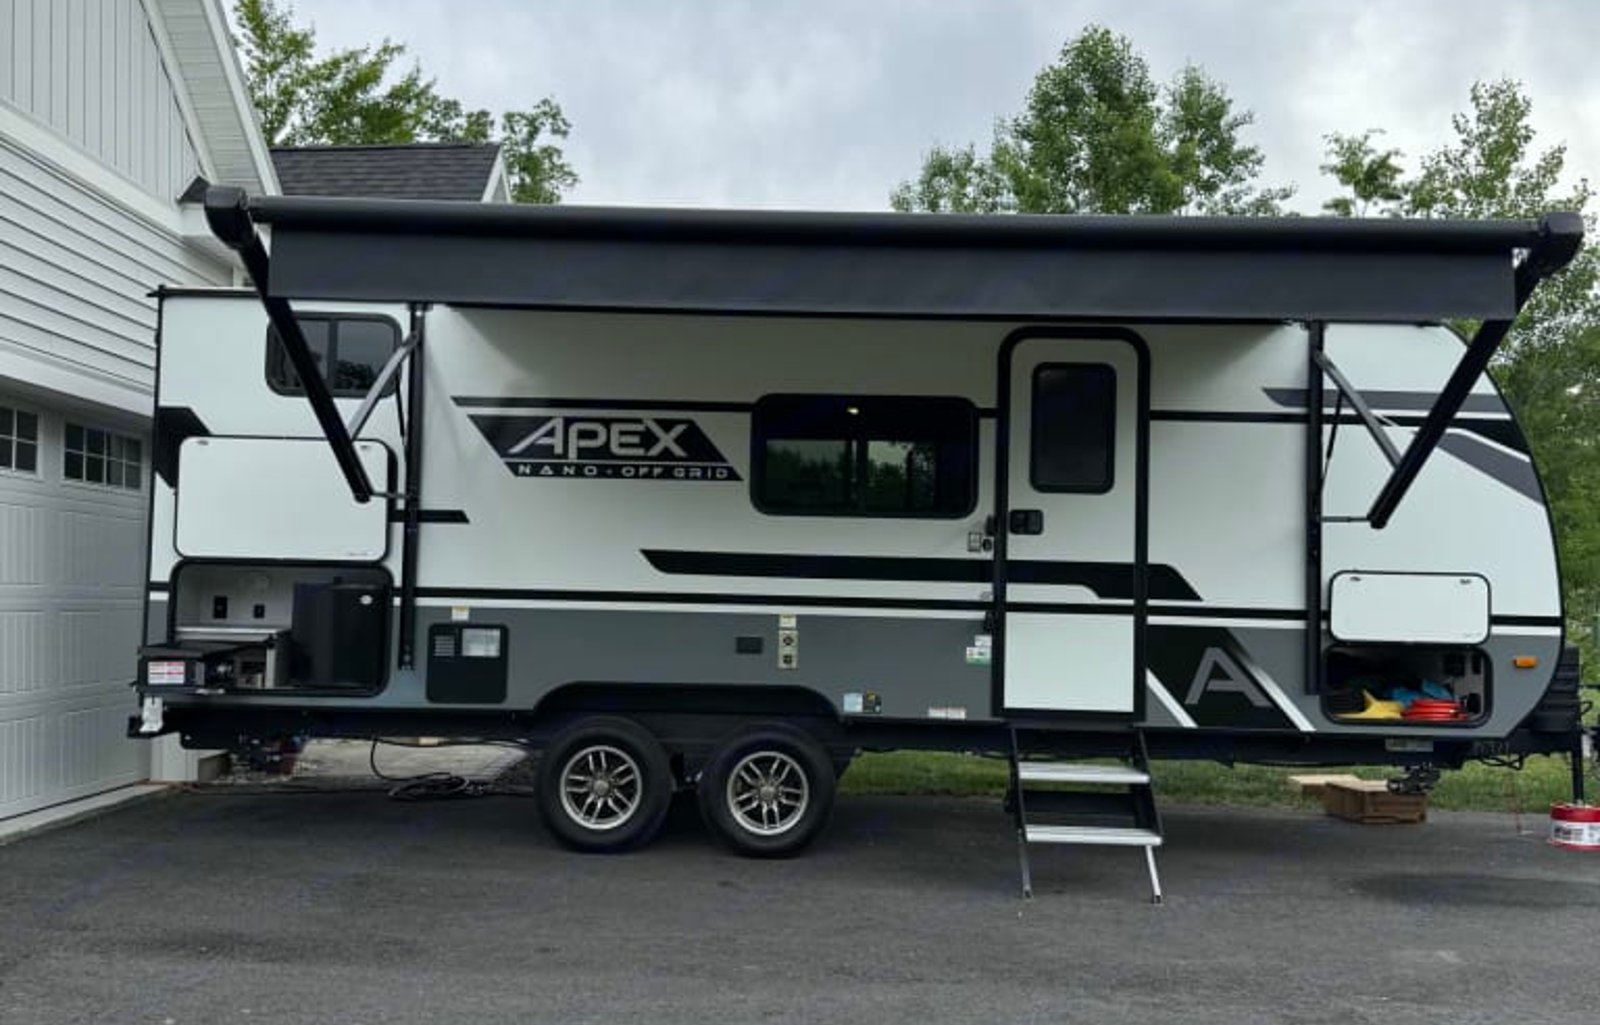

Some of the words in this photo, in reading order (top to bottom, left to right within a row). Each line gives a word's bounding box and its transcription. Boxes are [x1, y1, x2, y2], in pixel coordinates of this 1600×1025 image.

[508, 417, 690, 460] APEX
[518, 463, 598, 477] NANO
[621, 465, 664, 478] OFF
[673, 466, 729, 480] GRID
